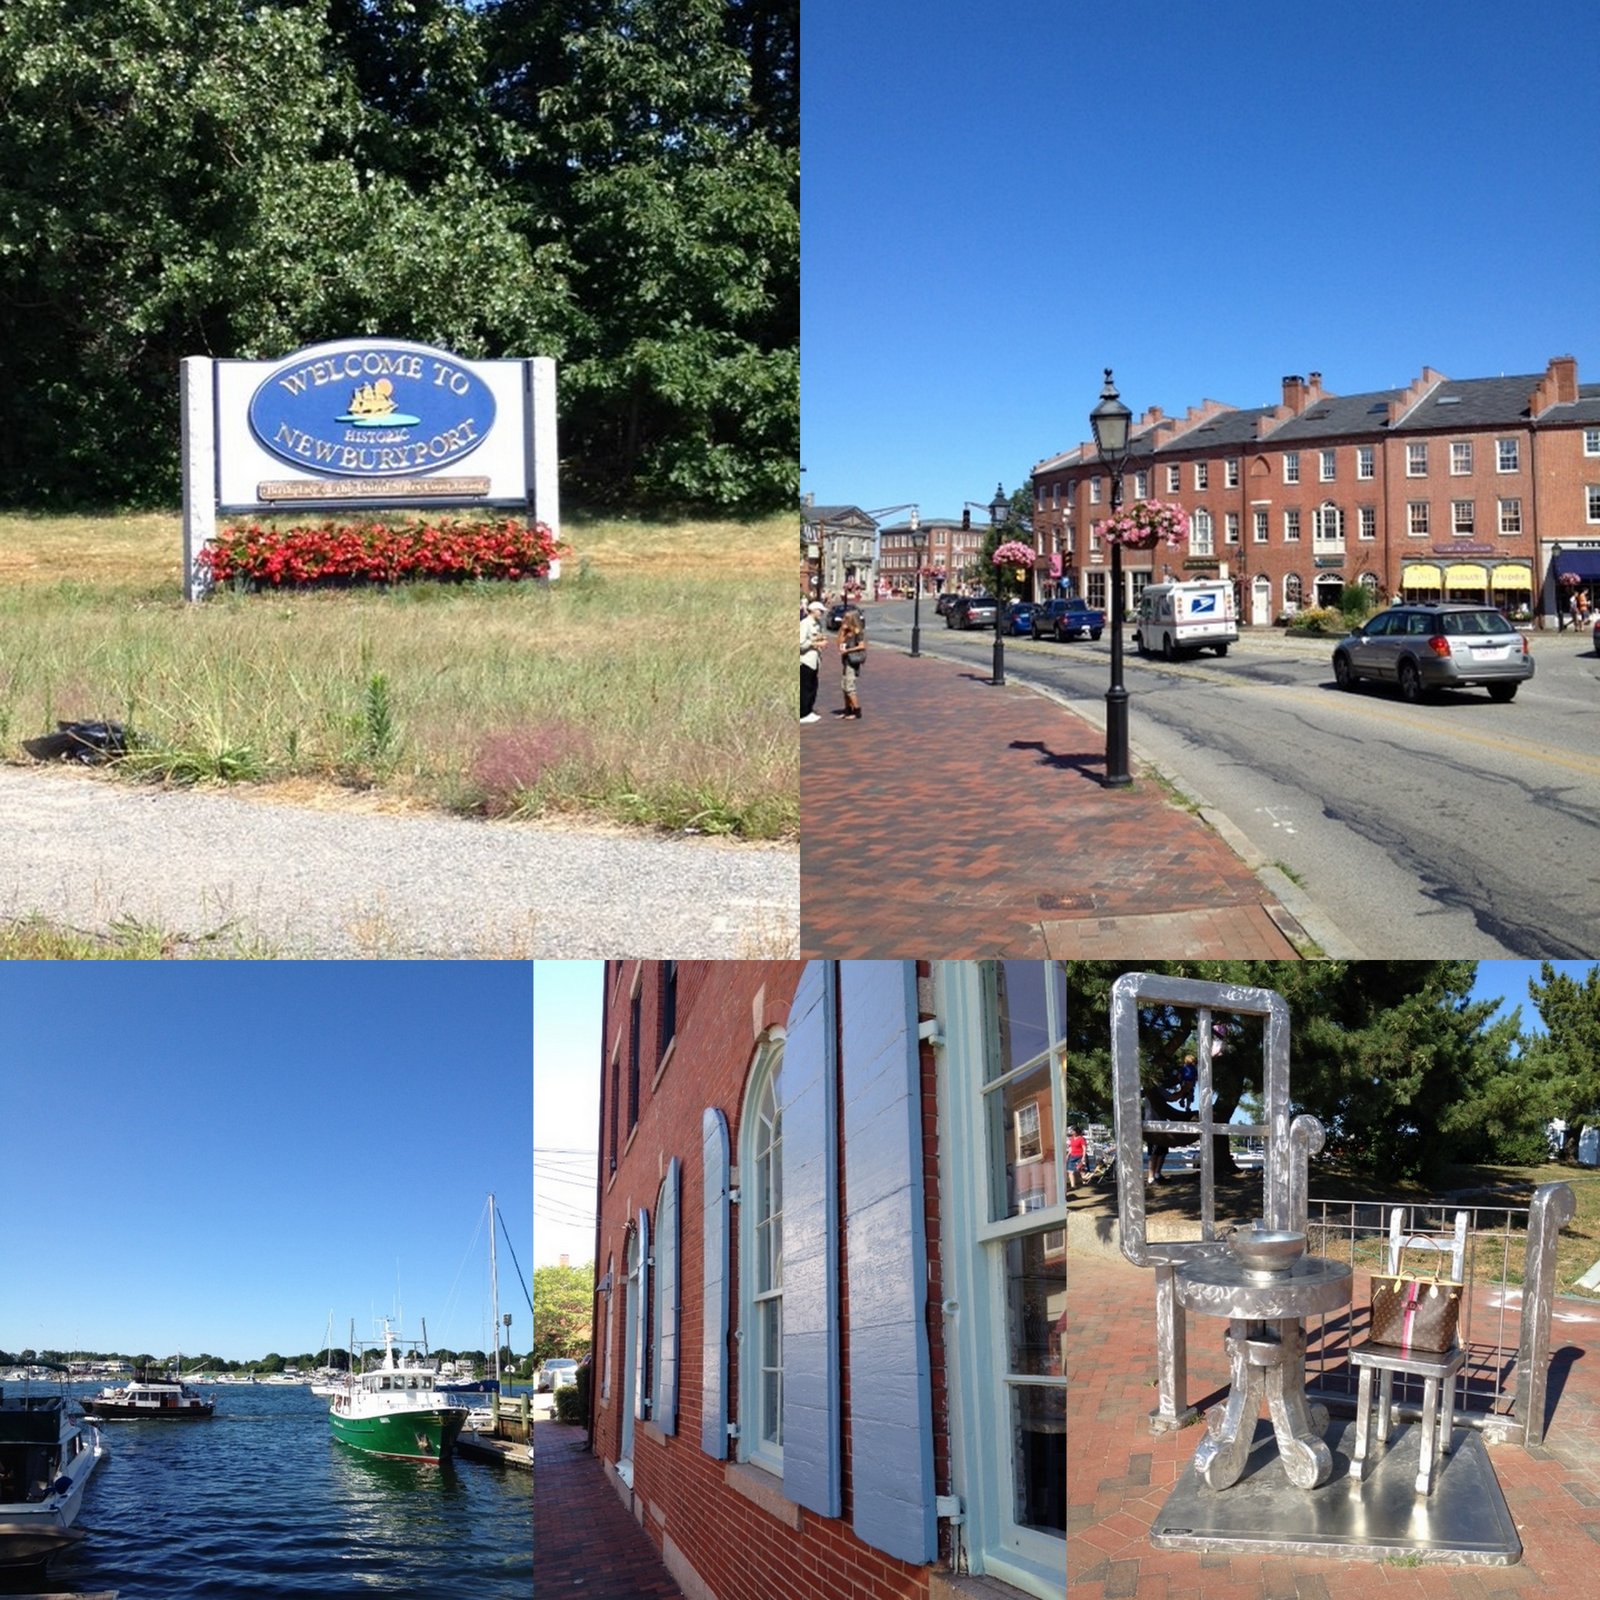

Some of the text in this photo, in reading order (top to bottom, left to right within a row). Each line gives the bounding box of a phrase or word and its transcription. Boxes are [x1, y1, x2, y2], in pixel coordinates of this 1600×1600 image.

[279, 353, 470, 396] WELCOME TO
[273, 418, 479, 469] NEWBURYPORT
[344, 428, 410, 444] HISTORIC
